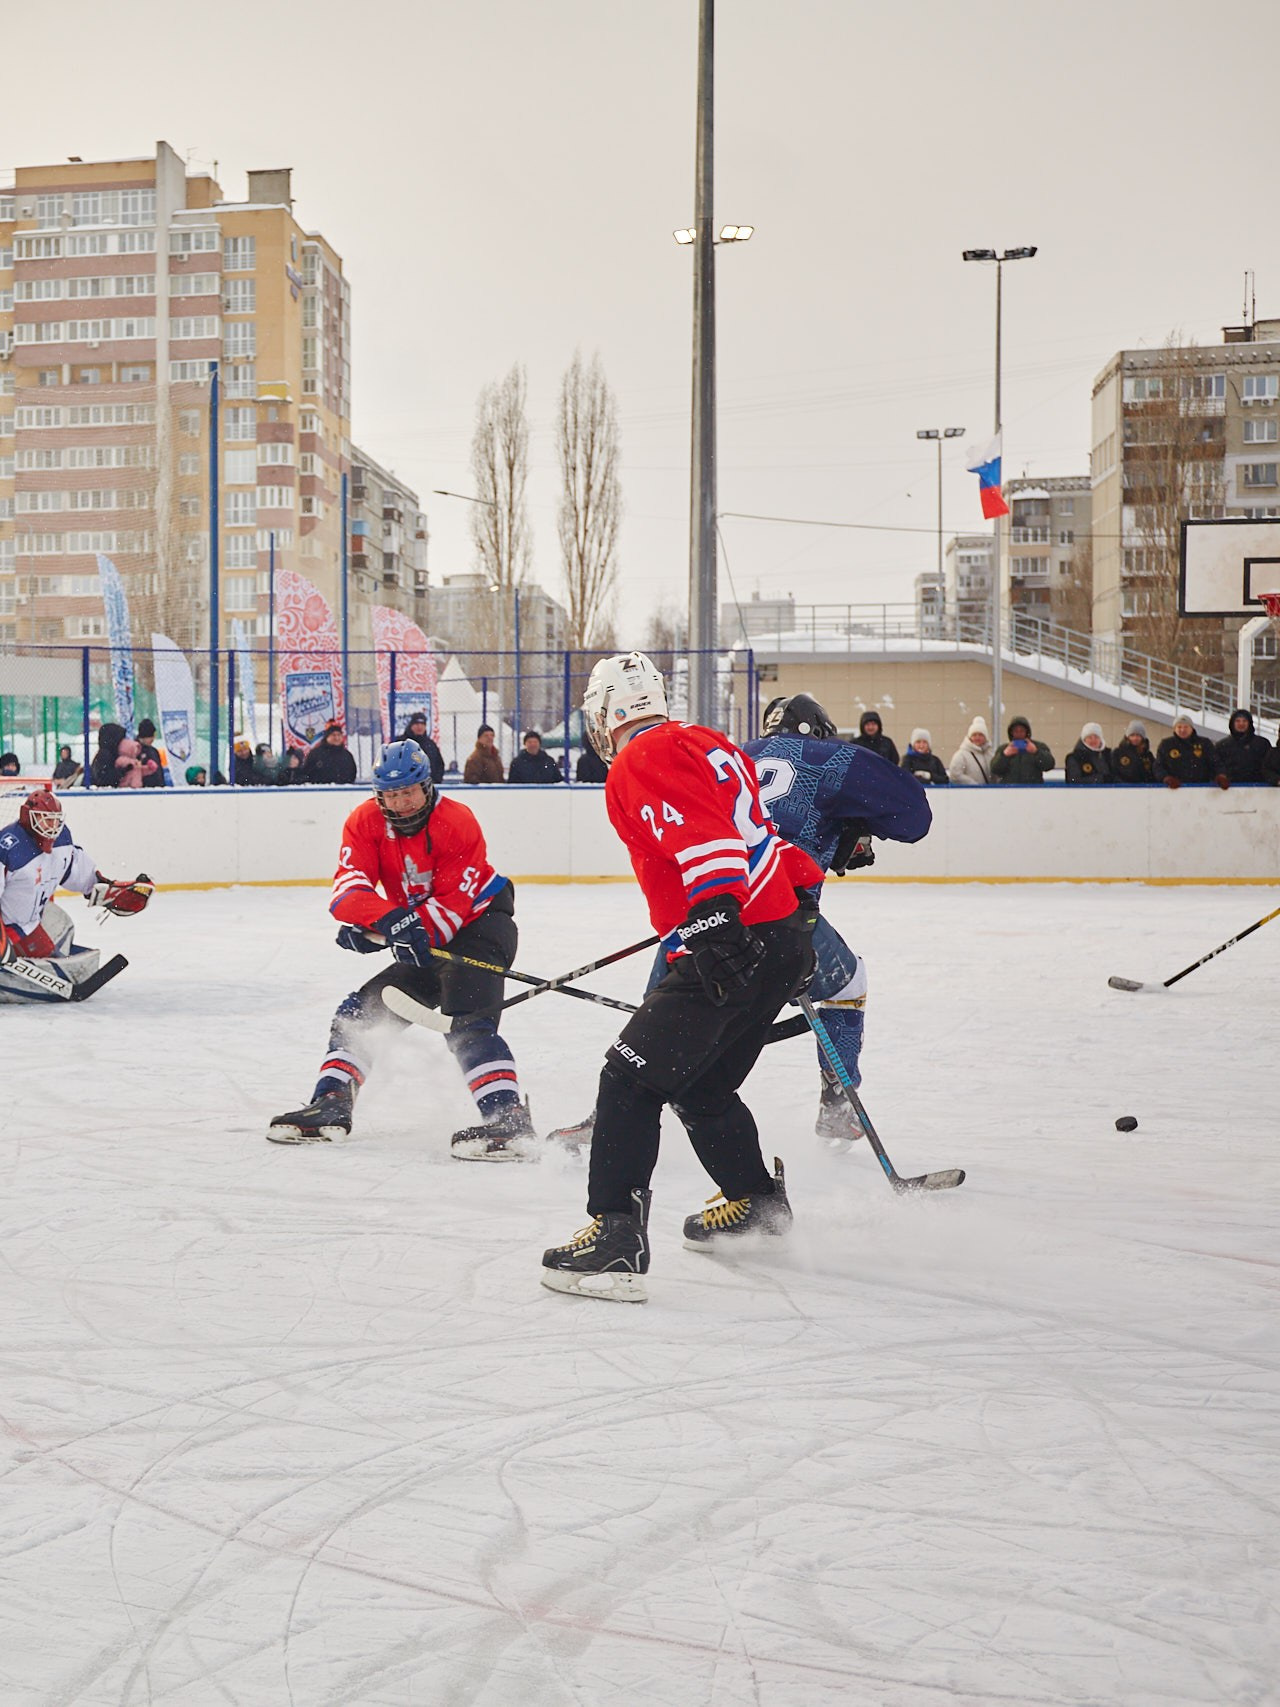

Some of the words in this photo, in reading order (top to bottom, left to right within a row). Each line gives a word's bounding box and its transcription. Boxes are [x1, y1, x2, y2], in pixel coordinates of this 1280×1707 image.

[640, 801, 684, 842] 24
[339, 846, 354, 869] 2
[391, 912, 420, 936] BAU
[677, 912, 729, 942] Reebok
[462, 956, 505, 973] TACKS
[613, 1040, 647, 1068] UER
[812, 1018, 852, 1088] WARRIOR
